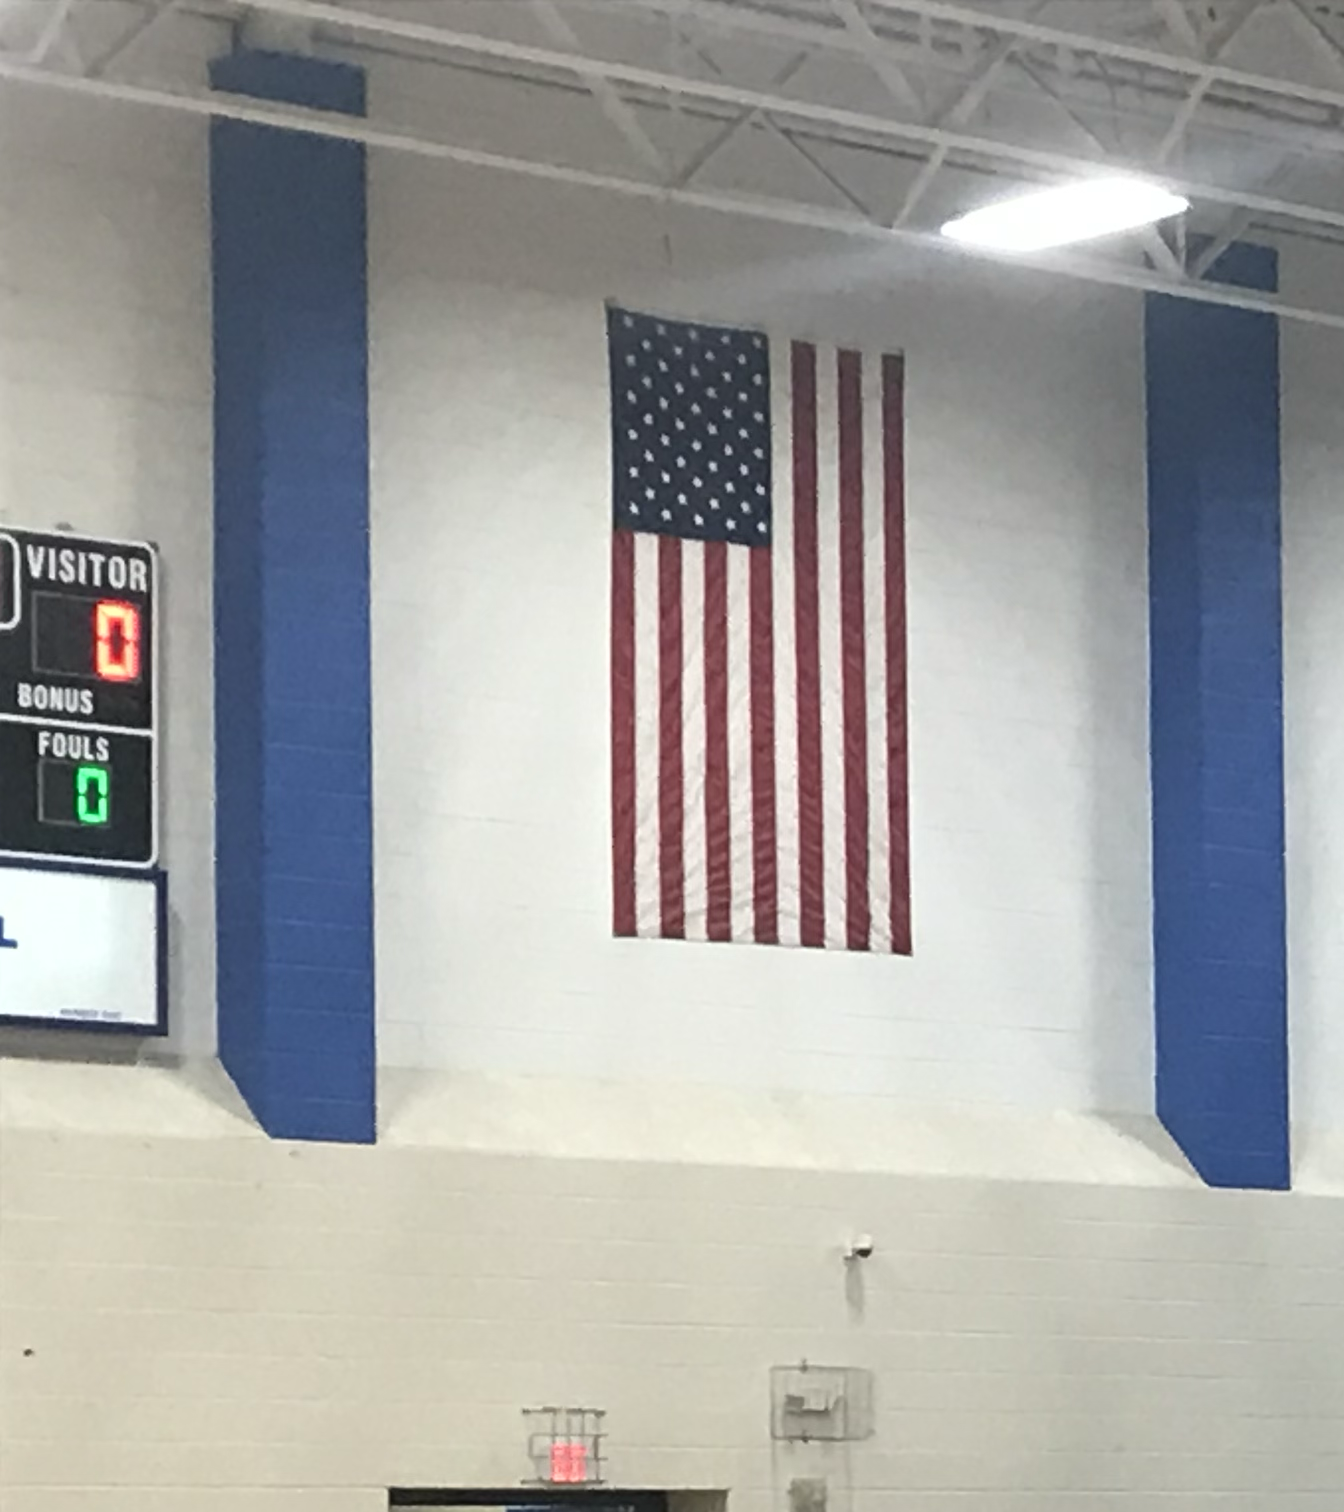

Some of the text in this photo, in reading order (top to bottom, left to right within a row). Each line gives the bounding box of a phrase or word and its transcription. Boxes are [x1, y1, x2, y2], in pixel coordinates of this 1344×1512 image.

[27, 545, 148, 592] VISITOR
[95, 601, 141, 682] 0
[17, 683, 94, 715] BONUS
[38, 731, 110, 762] FOULS
[76, 766, 109, 824] 0
